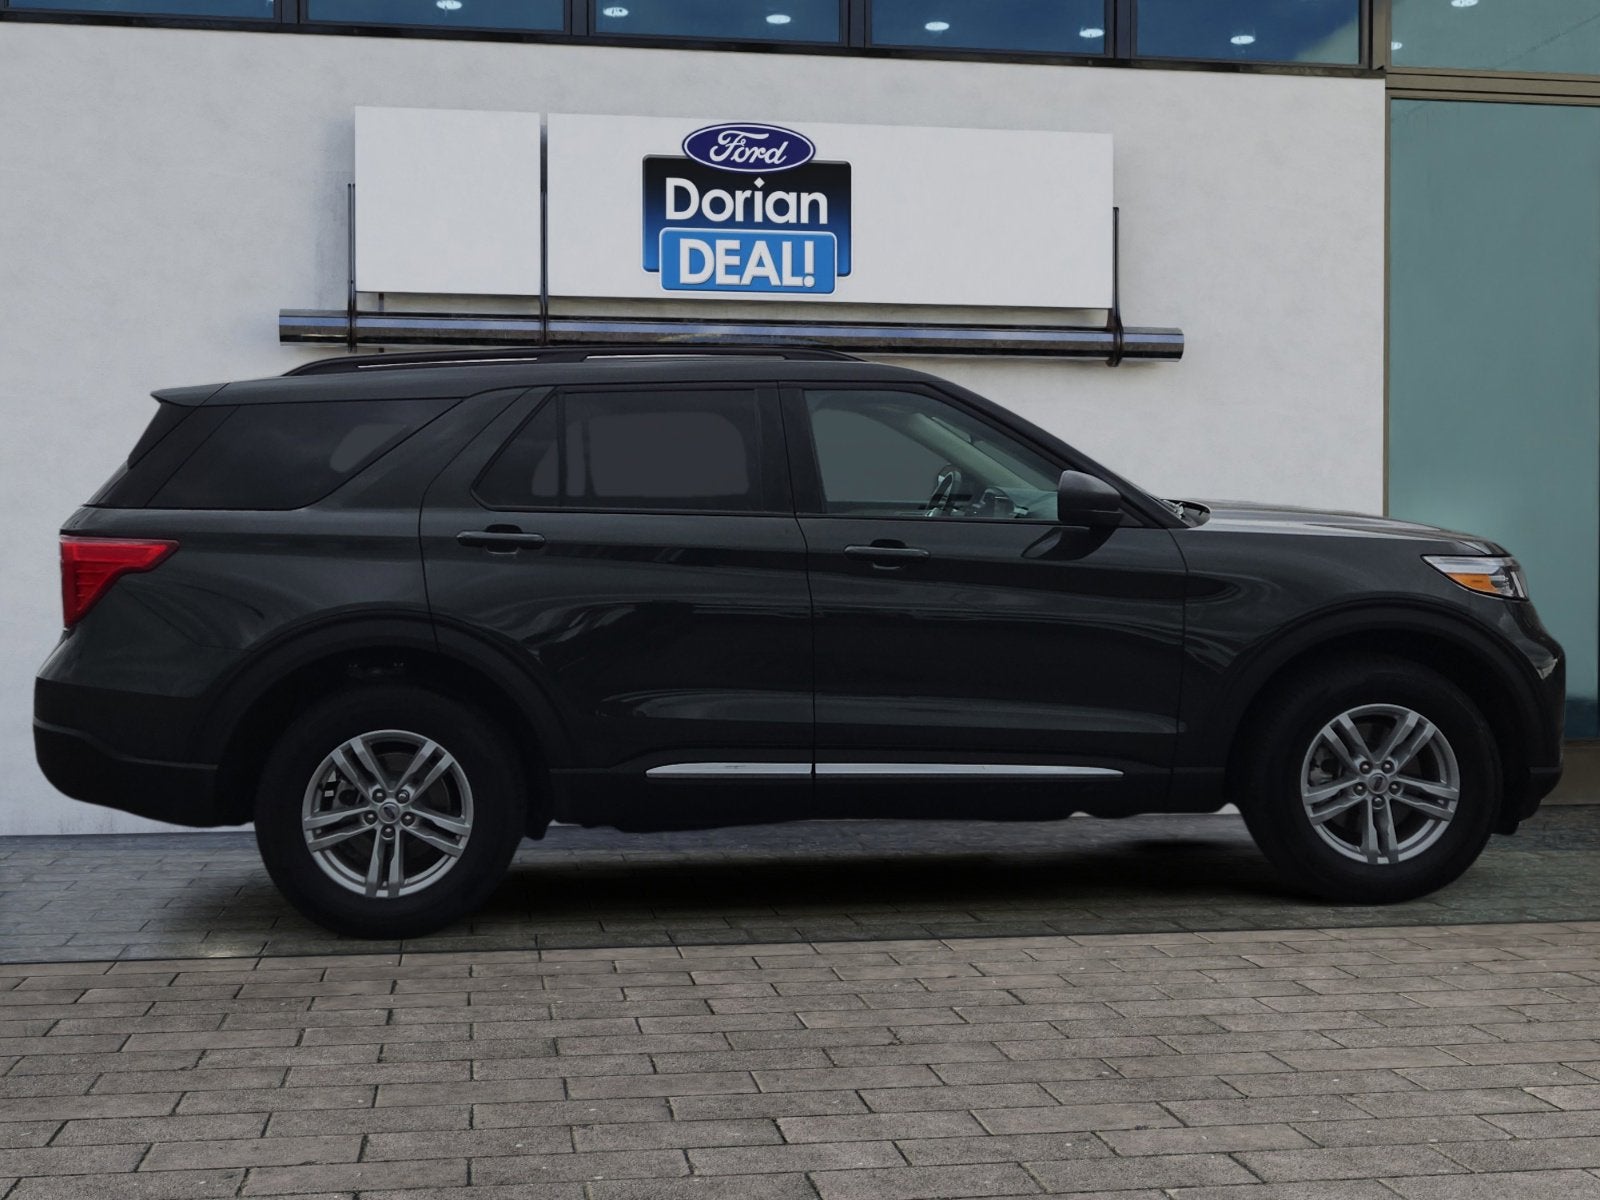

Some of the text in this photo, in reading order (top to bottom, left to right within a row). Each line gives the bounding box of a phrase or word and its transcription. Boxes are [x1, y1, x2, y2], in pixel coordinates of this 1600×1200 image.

[709, 130, 789, 165] Ford
[665, 177, 828, 225] Dorian
[679, 238, 815, 288] DEAL!
